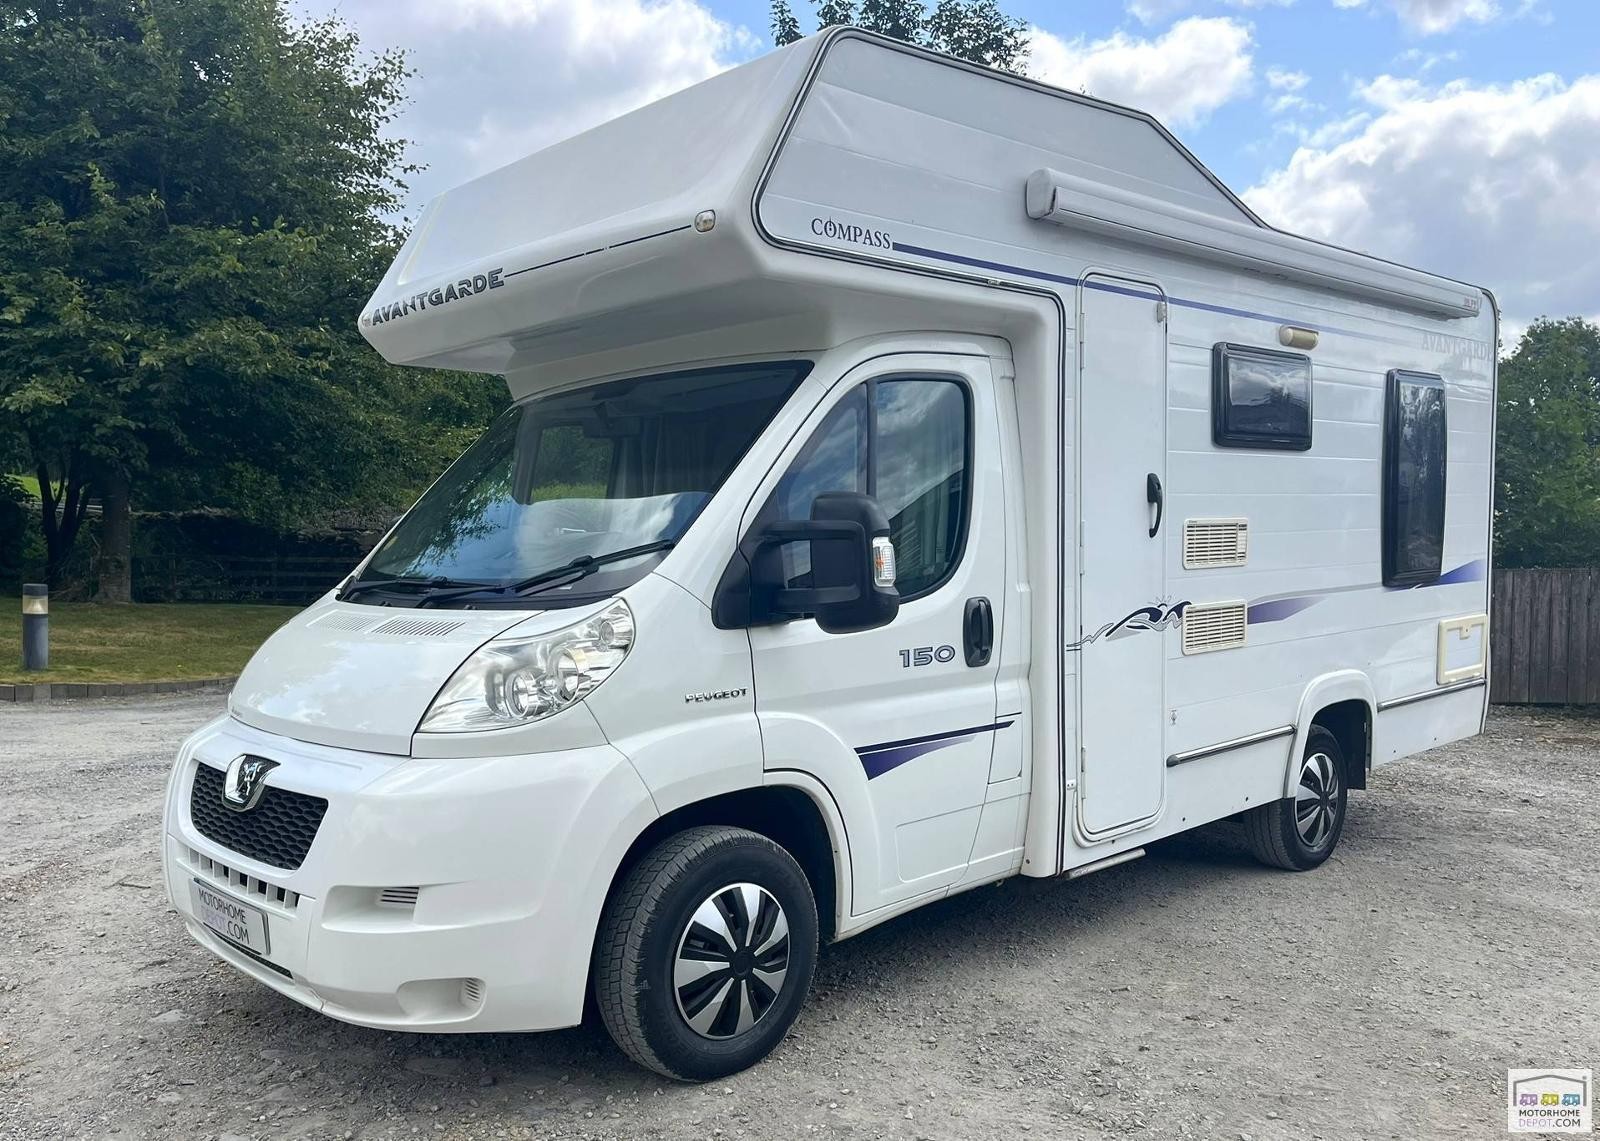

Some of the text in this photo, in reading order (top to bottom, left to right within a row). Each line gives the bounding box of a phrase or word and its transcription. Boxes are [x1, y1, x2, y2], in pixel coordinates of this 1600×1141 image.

[811, 216, 891, 249] COMPASS
[371, 267, 504, 327] AVANTGARDE
[898, 645, 956, 669] 150
[685, 688, 748, 704] PEUGEOT
[198, 888, 246, 925] MOTORHOME
